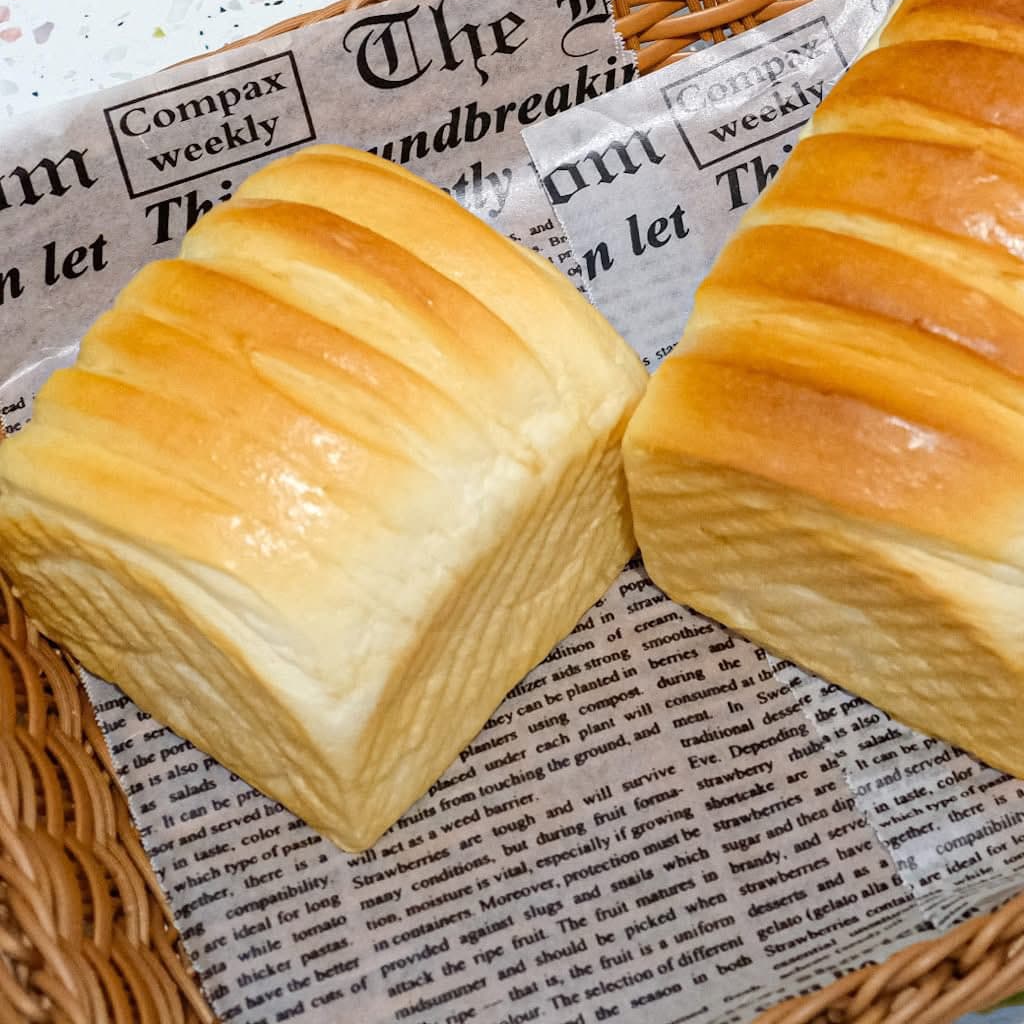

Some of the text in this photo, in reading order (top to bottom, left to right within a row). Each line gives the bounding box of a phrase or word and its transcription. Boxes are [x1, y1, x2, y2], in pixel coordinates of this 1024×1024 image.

[343, 0, 528, 89] The
[120, 72, 287, 136] Compax
[709, 81, 823, 142] weekly
[148, 115, 278, 171] weekly
[626, 205, 689, 255] let
[43, 234, 108, 285] let
[622, 766, 676, 792] survive
[697, 761, 772, 790] strawberry
[894, 767, 973, 805] taste, color
[536, 836, 610, 868] especially
[728, 851, 787, 874] brandy,
[238, 916, 347, 961] while tomato
[535, 907, 677, 966] should picked
[237, 960, 291, 988] thicker
[388, 971, 434, 997] attack
[584, 969, 654, 999] selection
